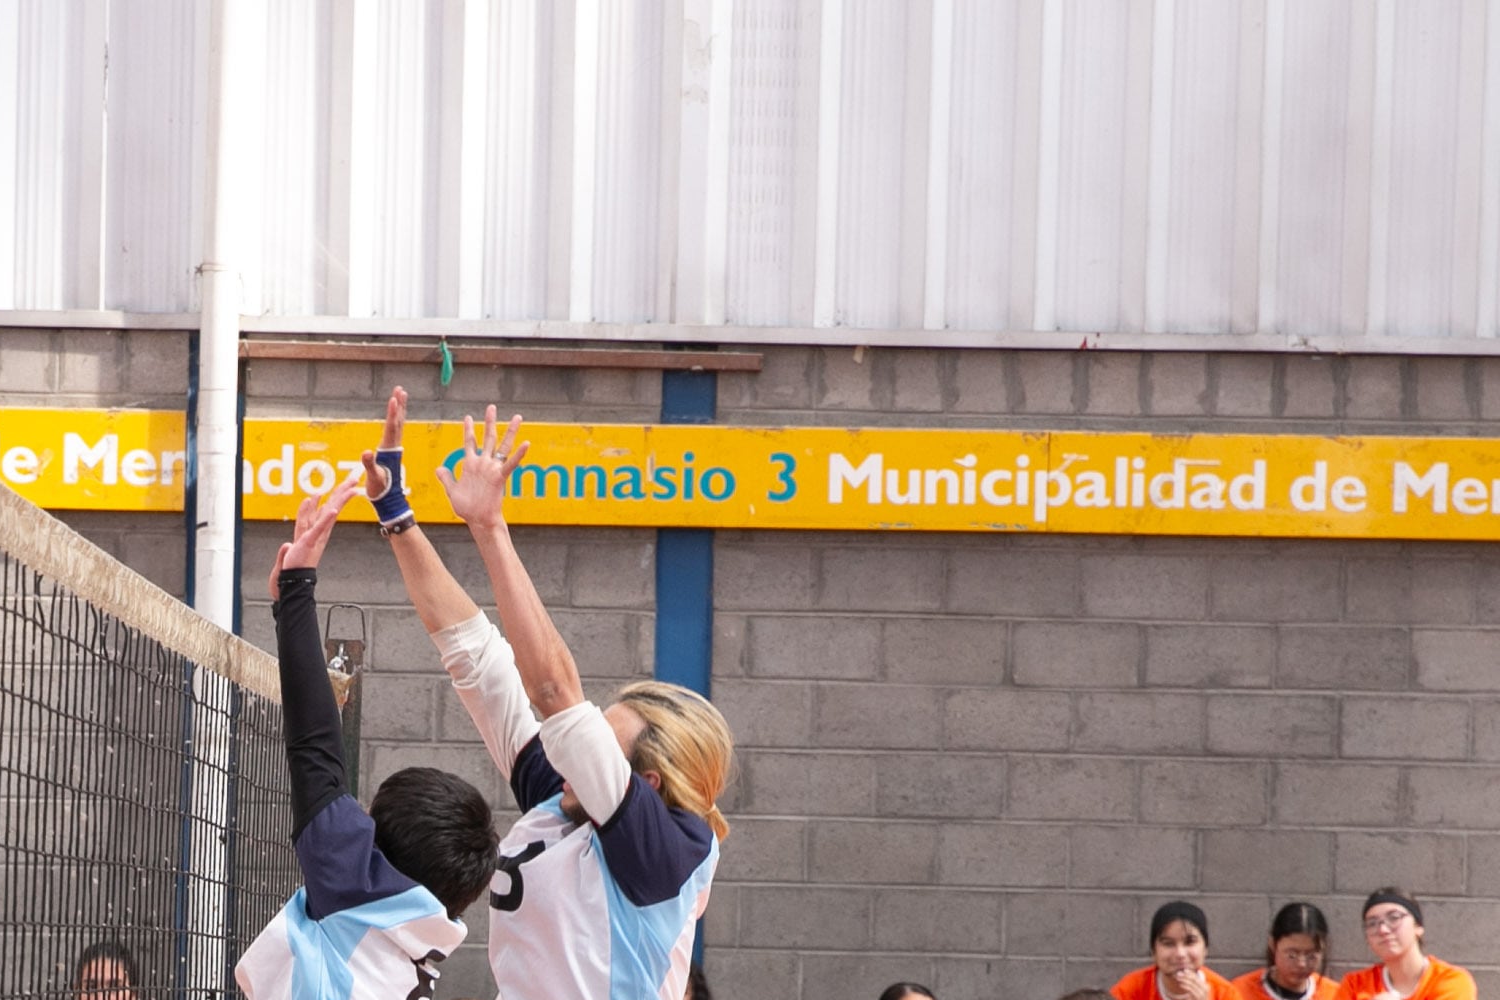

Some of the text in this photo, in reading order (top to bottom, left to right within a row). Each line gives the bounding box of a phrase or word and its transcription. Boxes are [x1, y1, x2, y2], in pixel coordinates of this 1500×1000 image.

[443, 447, 737, 501] mnasio
[767, 452, 798, 502] 3
[827, 453, 1267, 522] Municipalidad
[1290, 460, 1367, 512] de
[1392, 461, 1500, 514] Me
